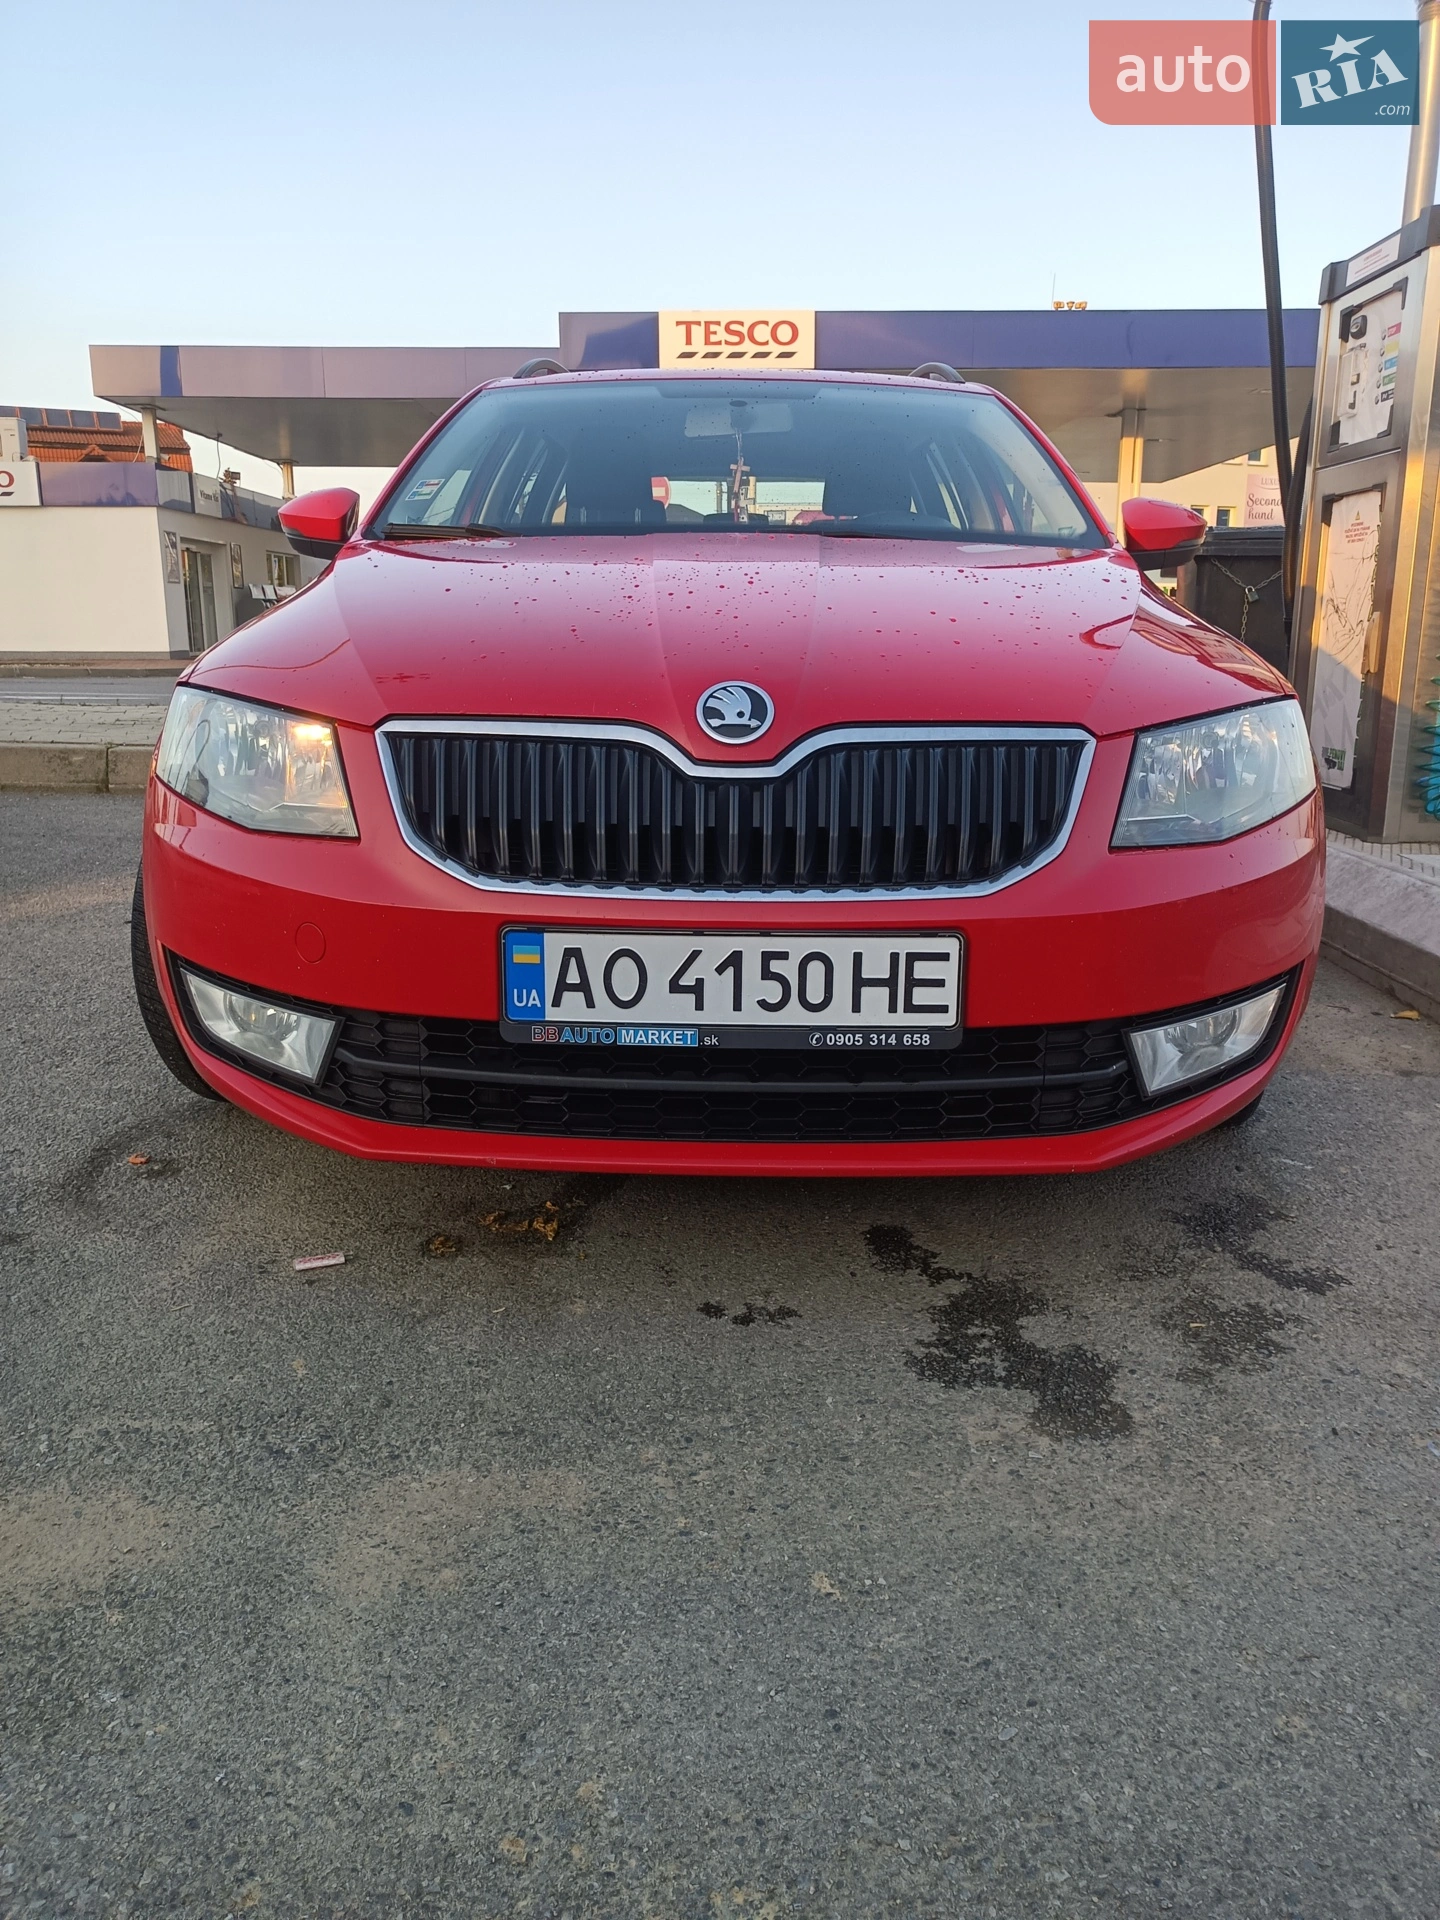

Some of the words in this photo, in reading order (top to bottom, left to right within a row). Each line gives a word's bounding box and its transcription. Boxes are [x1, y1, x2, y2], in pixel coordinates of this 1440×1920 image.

[676, 320, 799, 346] TESCO
[1248, 508, 1275, 520] hand
[551, 946, 648, 1010] AO
[668, 948, 834, 1013] 4150
[851, 951, 950, 1014] HE
[513, 988, 541, 1008] UA
[621, 1029, 695, 1045] MARKET
[826, 1033, 863, 1046] 0905
[869, 1033, 897, 1046] 314
[903, 1033, 930, 1046] 658
